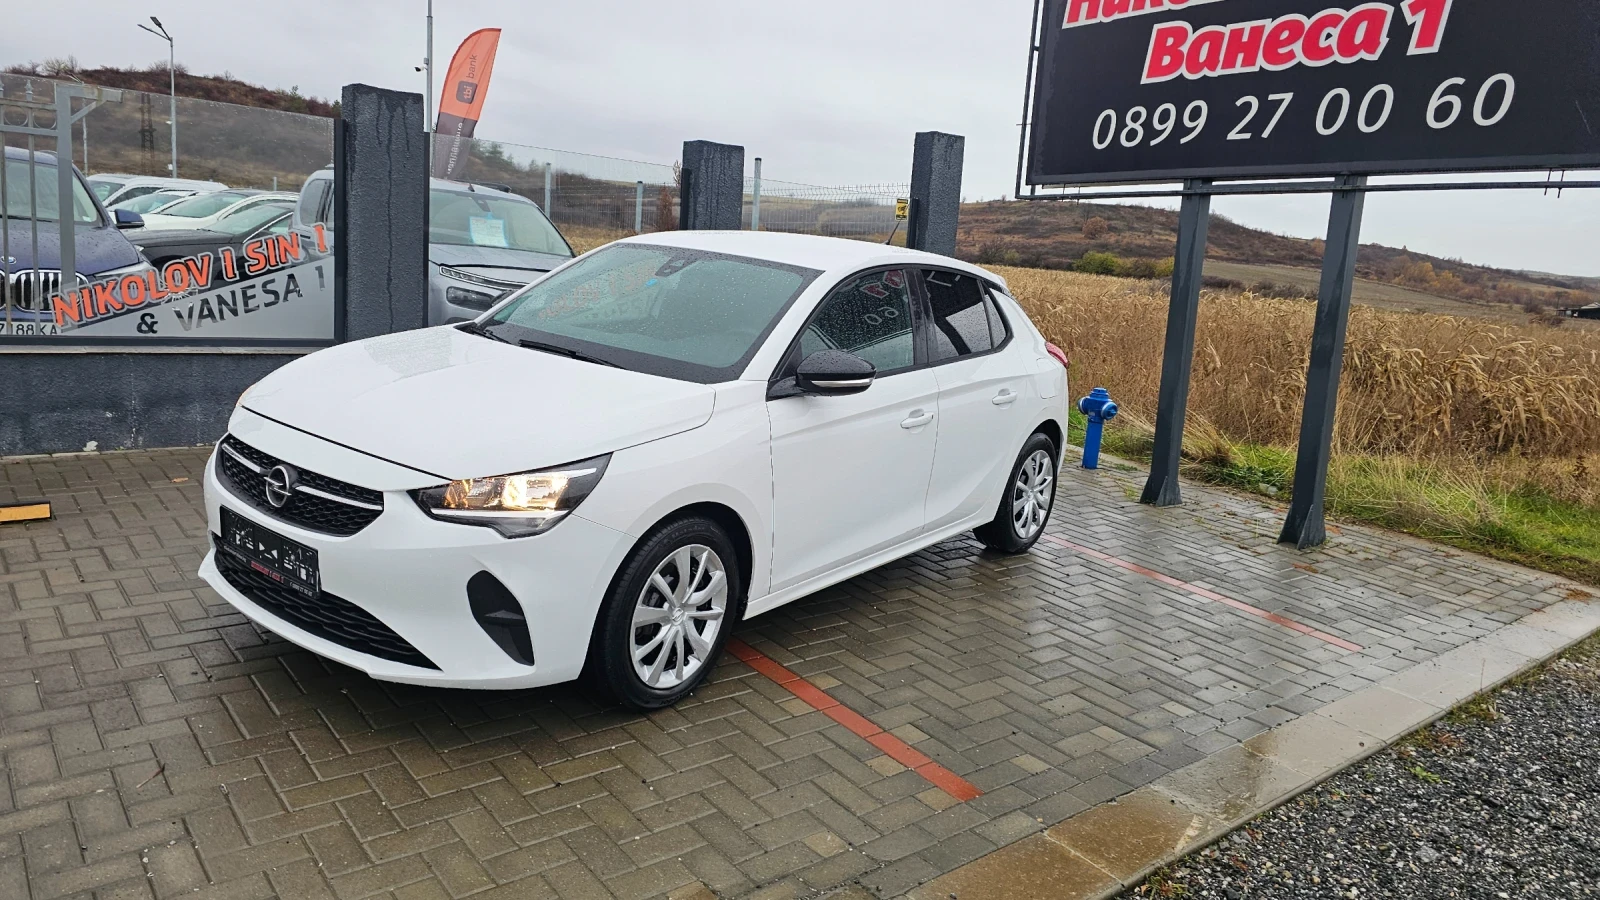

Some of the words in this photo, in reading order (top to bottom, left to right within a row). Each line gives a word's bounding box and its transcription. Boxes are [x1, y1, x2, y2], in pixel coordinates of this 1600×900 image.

[466, 54, 478, 79] bank
[1142, 4, 1392, 82] Ванеса
[1403, 0, 1450, 53] 1
[463, 85, 473, 99] tbi
[1092, 99, 1208, 150] 0899
[1227, 92, 1293, 141] 27
[1315, 83, 1394, 136] 00
[1425, 72, 1516, 129] 60
[51, 254, 213, 328] NIKOLOV
[244, 232, 302, 273] SIN
[137, 312, 158, 334] &
[173, 273, 303, 331] VANESA
